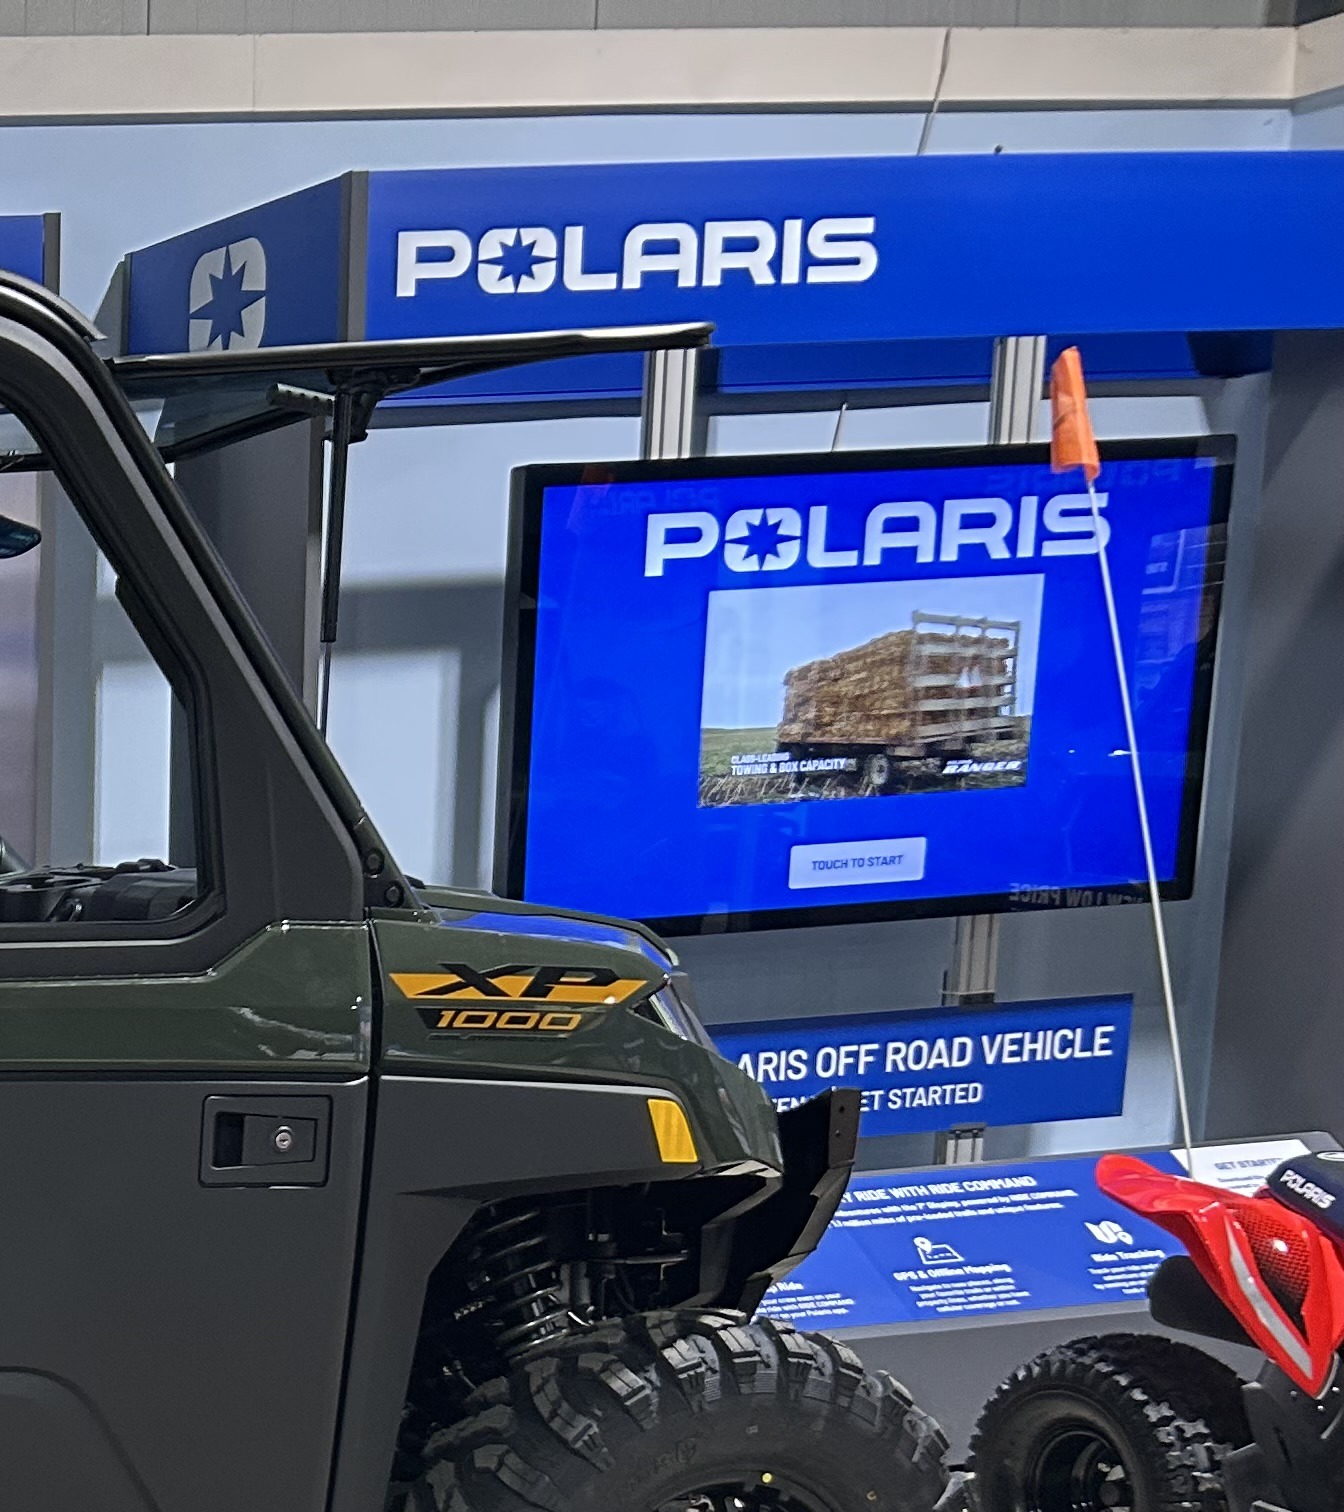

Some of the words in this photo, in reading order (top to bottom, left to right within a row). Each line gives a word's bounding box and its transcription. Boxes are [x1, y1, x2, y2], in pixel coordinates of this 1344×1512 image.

[396, 216, 879, 297] POLARIS
[644, 492, 1111, 577] POLARIS
[800, 758, 846, 772] CAPACITY
[942, 760, 1022, 774] RANGER
[811, 859, 849, 871] TOUCH
[851, 858, 864, 869] TO
[866, 855, 904, 868] START
[414, 962, 621, 998] XP
[437, 1009, 582, 1031] 1000
[815, 1043, 879, 1078] OFF
[885, 1036, 973, 1073] ROAD
[981, 1025, 1116, 1065] VEHICLE
[887, 1083, 983, 1109] STARTED
[854, 1188, 889, 1203] RIDE
[889, 1185, 925, 1199] WITH
[927, 1182, 962, 1196] RIDE
[962, 1176, 1037, 1192] COMMAND
[1280, 1169, 1336, 1209] POLARIS
